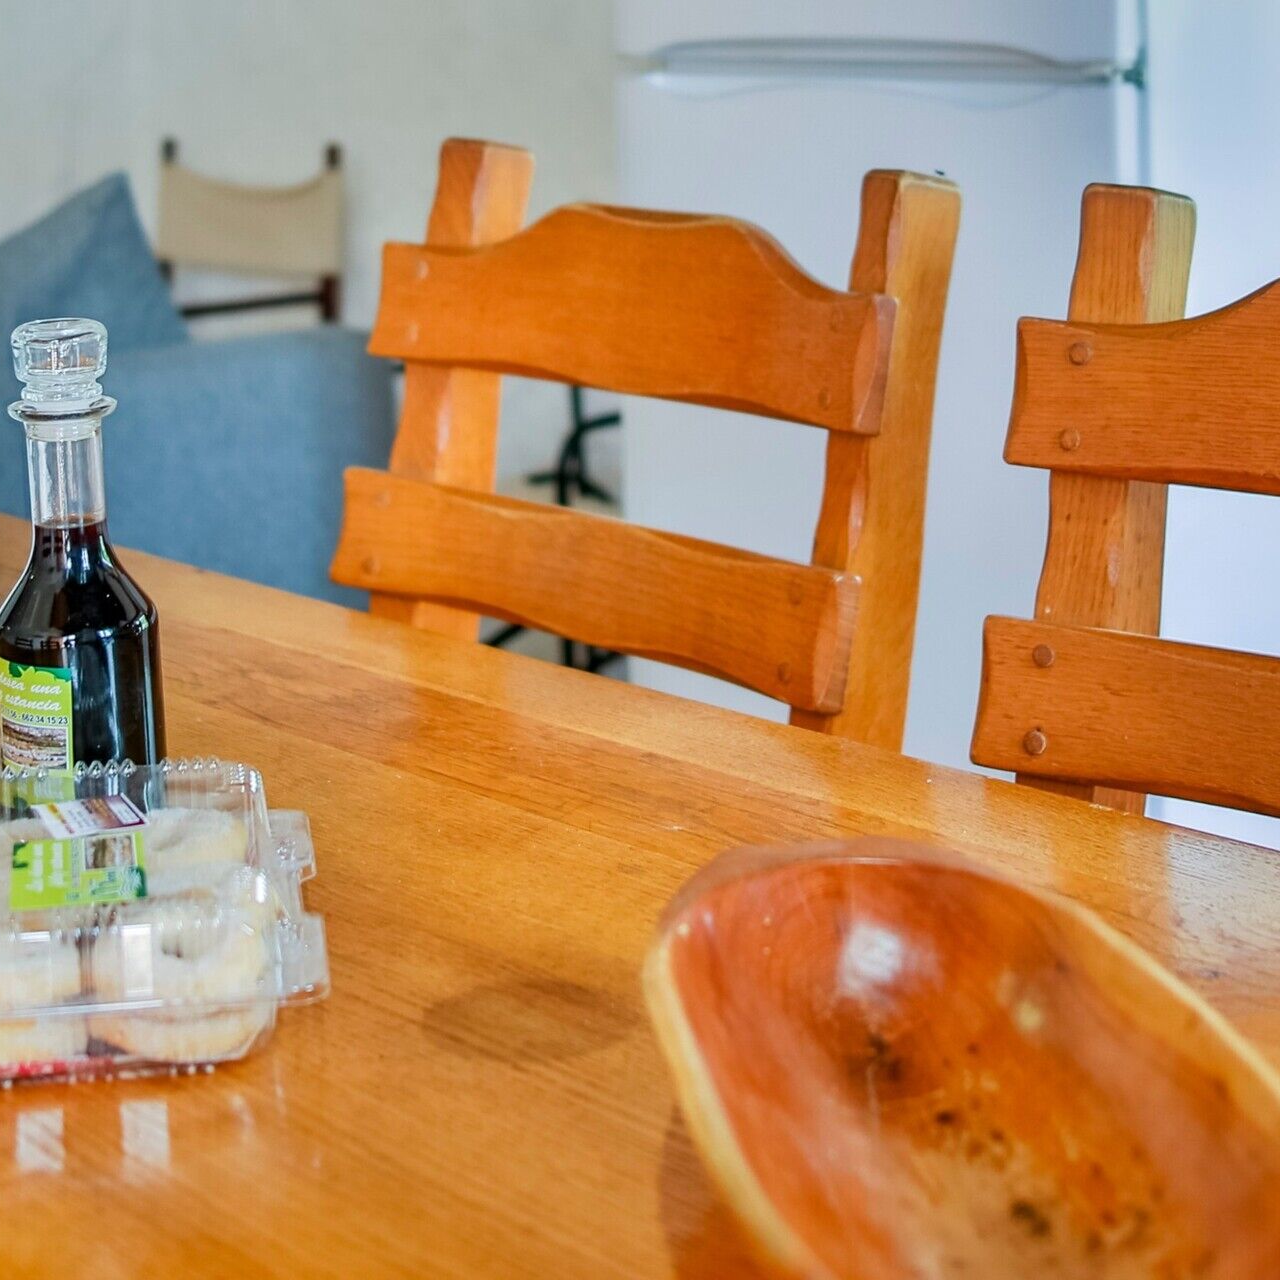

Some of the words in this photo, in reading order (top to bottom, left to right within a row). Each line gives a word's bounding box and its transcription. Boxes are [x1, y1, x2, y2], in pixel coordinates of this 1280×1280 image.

[32, 684, 61, 694] una
[47, 716, 56, 724] 15
[59, 716, 68, 724] 23
